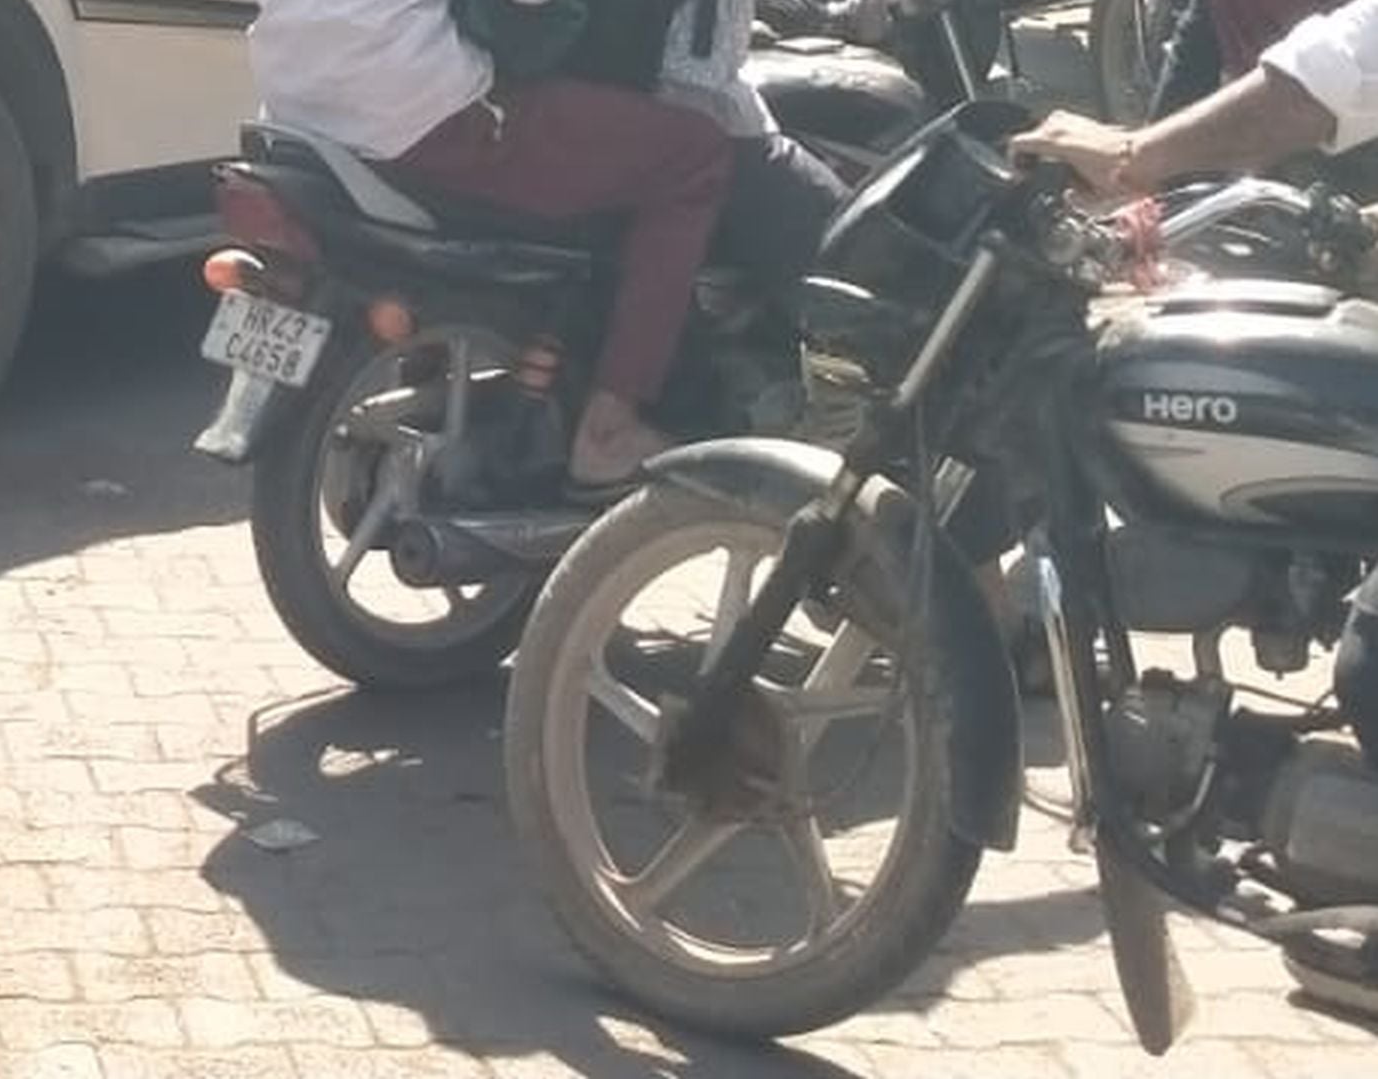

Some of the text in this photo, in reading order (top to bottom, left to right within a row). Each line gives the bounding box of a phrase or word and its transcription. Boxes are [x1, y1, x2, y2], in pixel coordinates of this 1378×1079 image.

[243, 305, 307, 343] HR43
[225, 331, 302, 378] C4658
[1142, 392, 1238, 424] Hero
